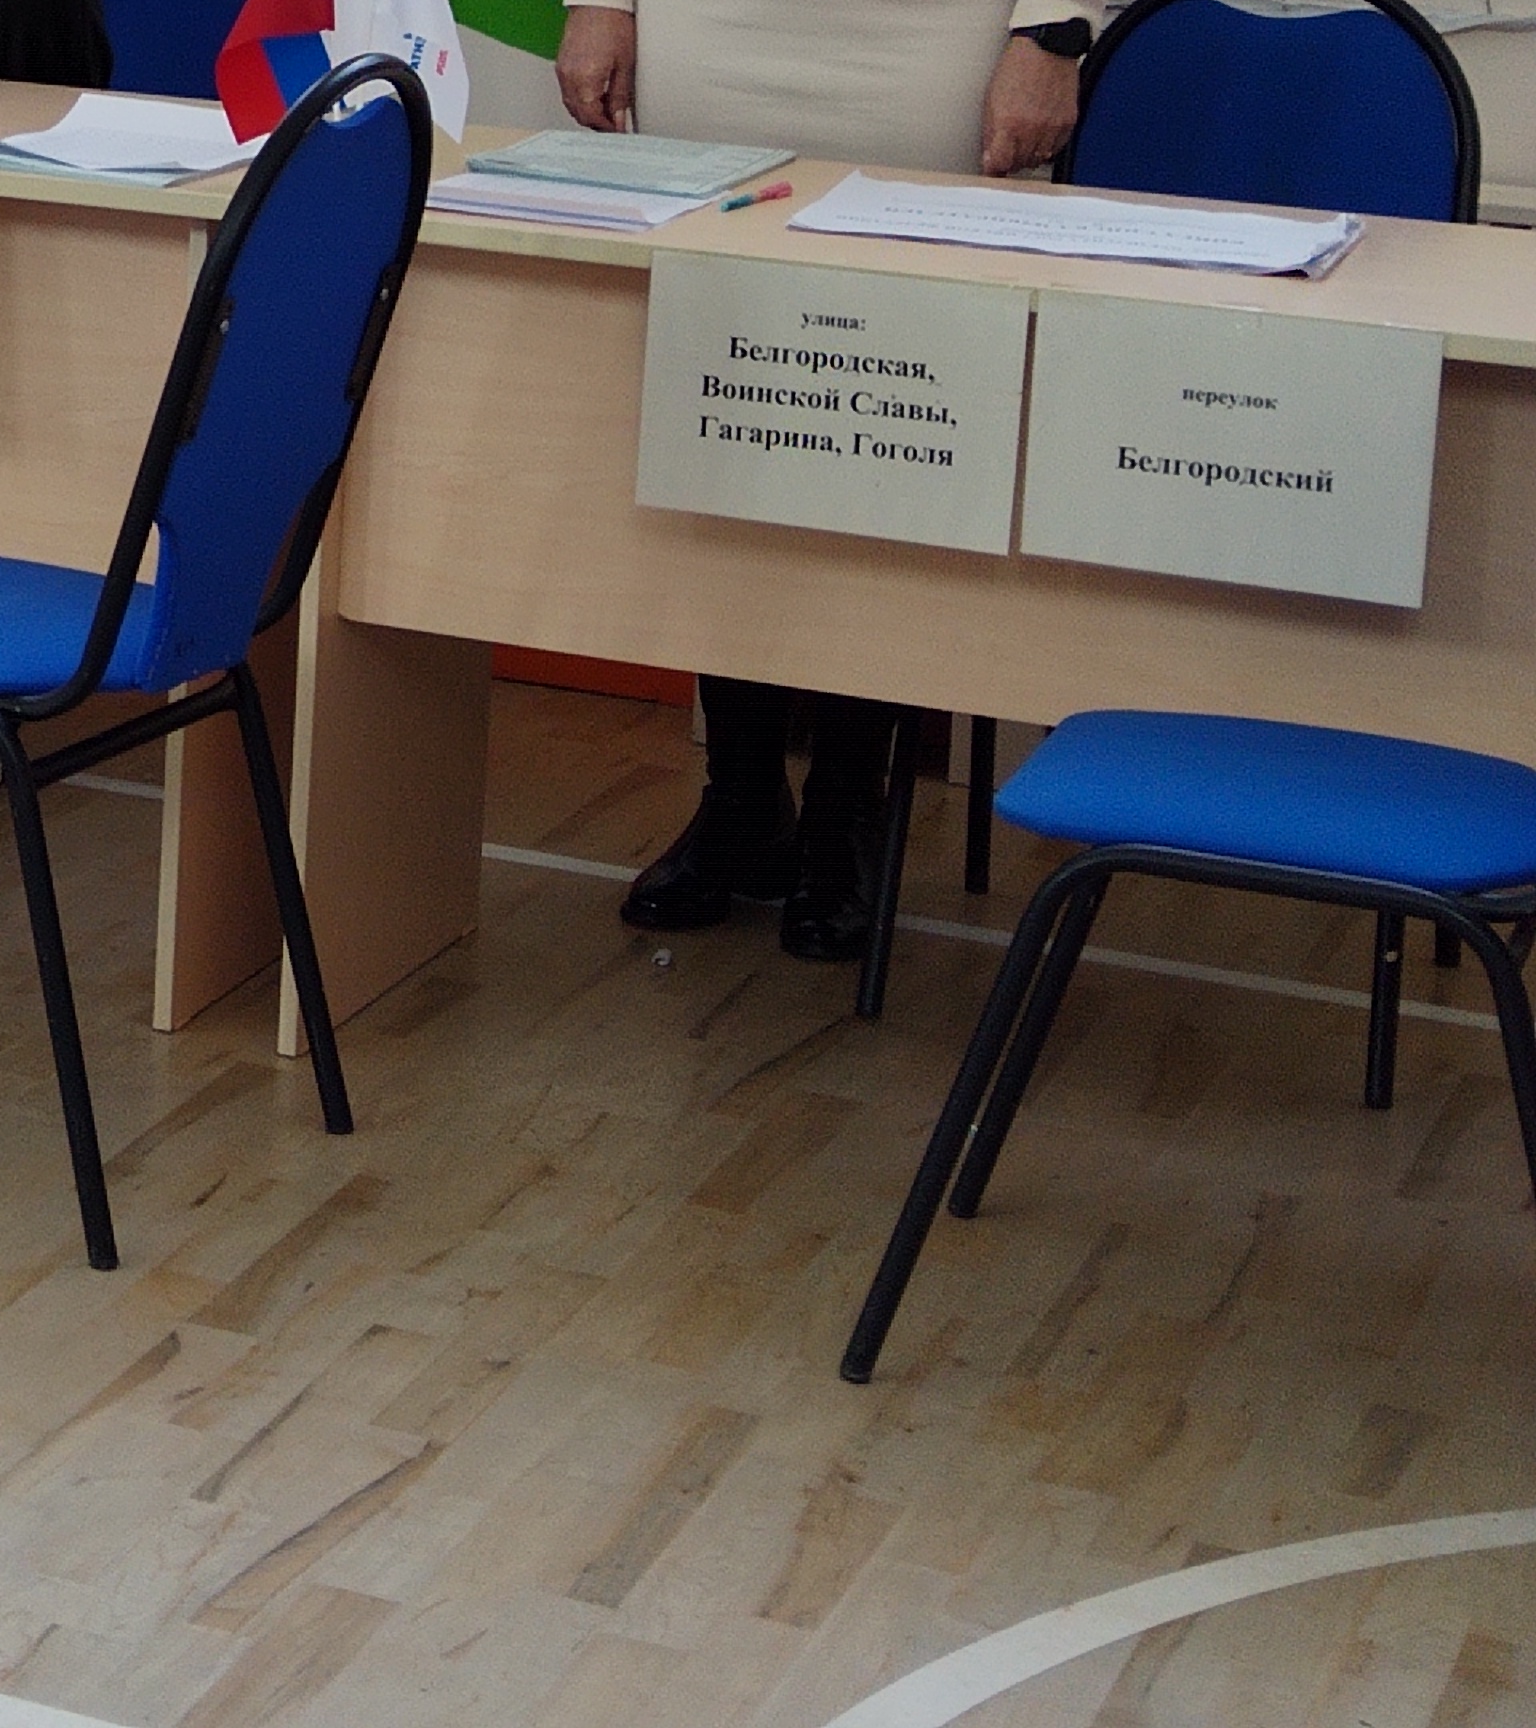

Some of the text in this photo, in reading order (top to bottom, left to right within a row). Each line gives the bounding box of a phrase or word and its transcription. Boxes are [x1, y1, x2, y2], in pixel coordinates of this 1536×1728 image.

[800, 309, 867, 333] улица:
[727, 335, 936, 384] Белгородская,
[700, 374, 958, 430] Воинской Славы,
[1181, 384, 1279, 412] переулок
[697, 414, 955, 468] Гагарина, Гоголя
[1115, 444, 1335, 495] Белгородский
